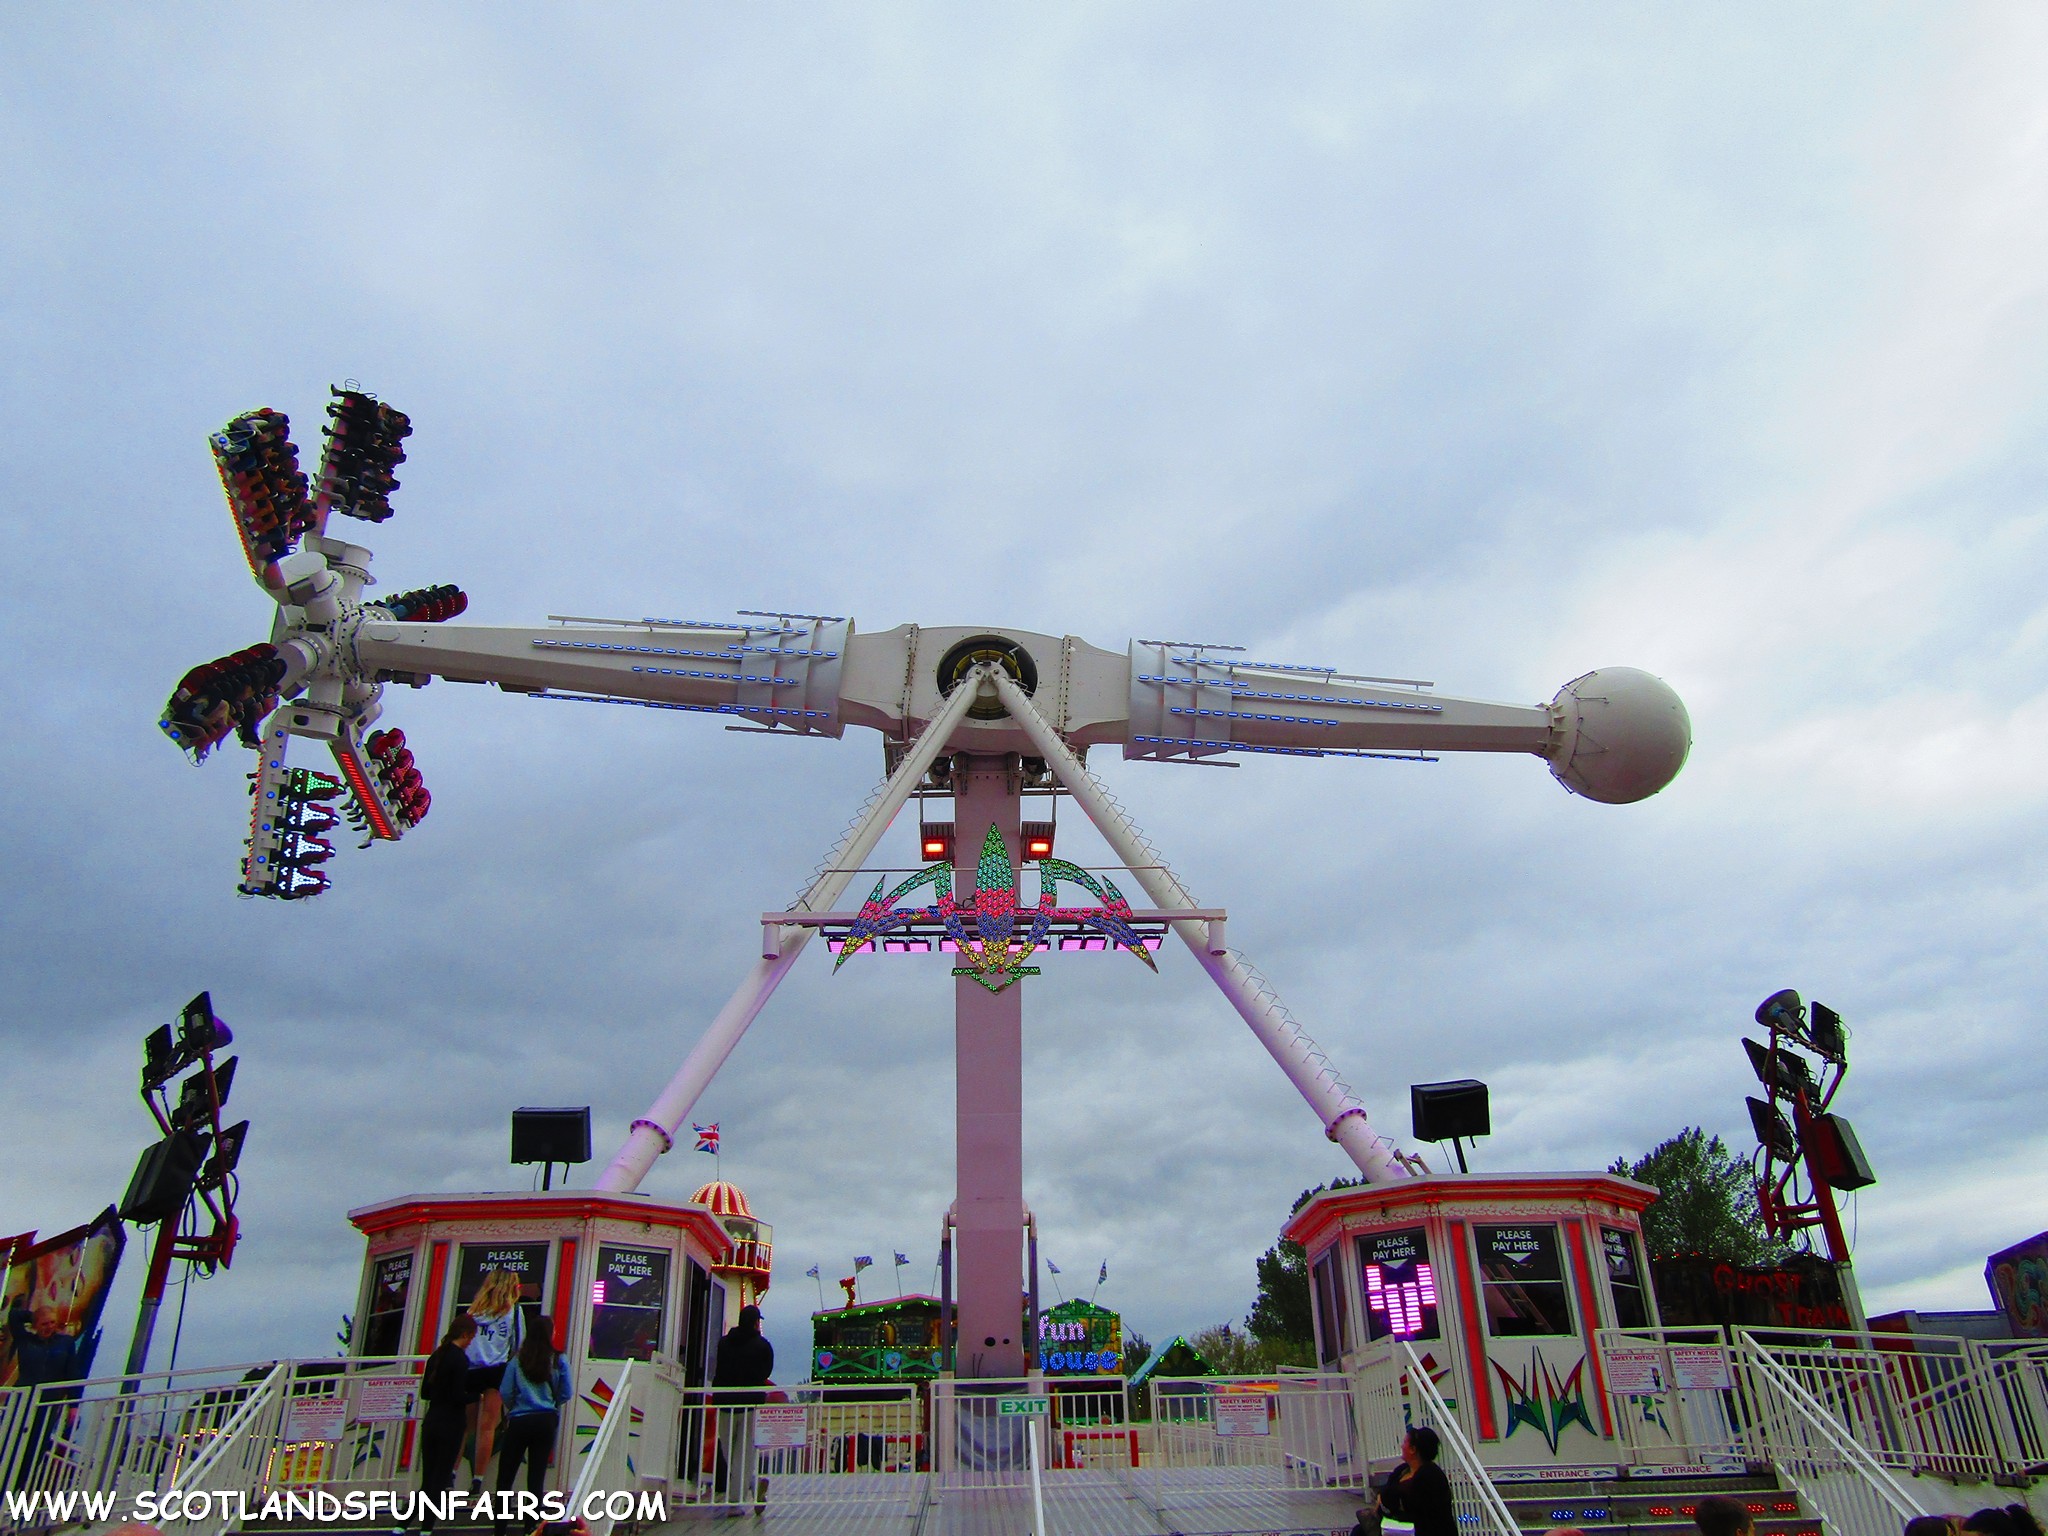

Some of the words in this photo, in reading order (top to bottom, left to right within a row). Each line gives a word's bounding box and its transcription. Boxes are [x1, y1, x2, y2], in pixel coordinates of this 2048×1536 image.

[1497, 1230, 1532, 1240] PLEASE
[1377, 1236, 1409, 1249] PLEASE
[1492, 1241, 1511, 1251] PAY
[1513, 1240, 1539, 1251] HERE
[488, 1251, 525, 1261] PLEASE
[615, 1253, 648, 1265] PLEASE
[1372, 1248, 1391, 1261] PAY
[1393, 1246, 1416, 1258] HERE
[388, 1258, 409, 1270] PLEASE
[480, 1262, 498, 1272] PAY
[503, 1261, 530, 1271] HERE
[608, 1263, 626, 1274] PAY
[629, 1265, 652, 1276] HERE
[383, 1273, 395, 1283] PAY
[395, 1268, 411, 1279] HERE
[1713, 1264, 1803, 1296] GHOST
[1039, 1315, 1085, 1341] fun
[1001, 1400, 1047, 1413] EXIT
[1539, 1469, 1590, 1479] ENTRANCE
[1662, 1465, 1712, 1474] ENTRANCE
